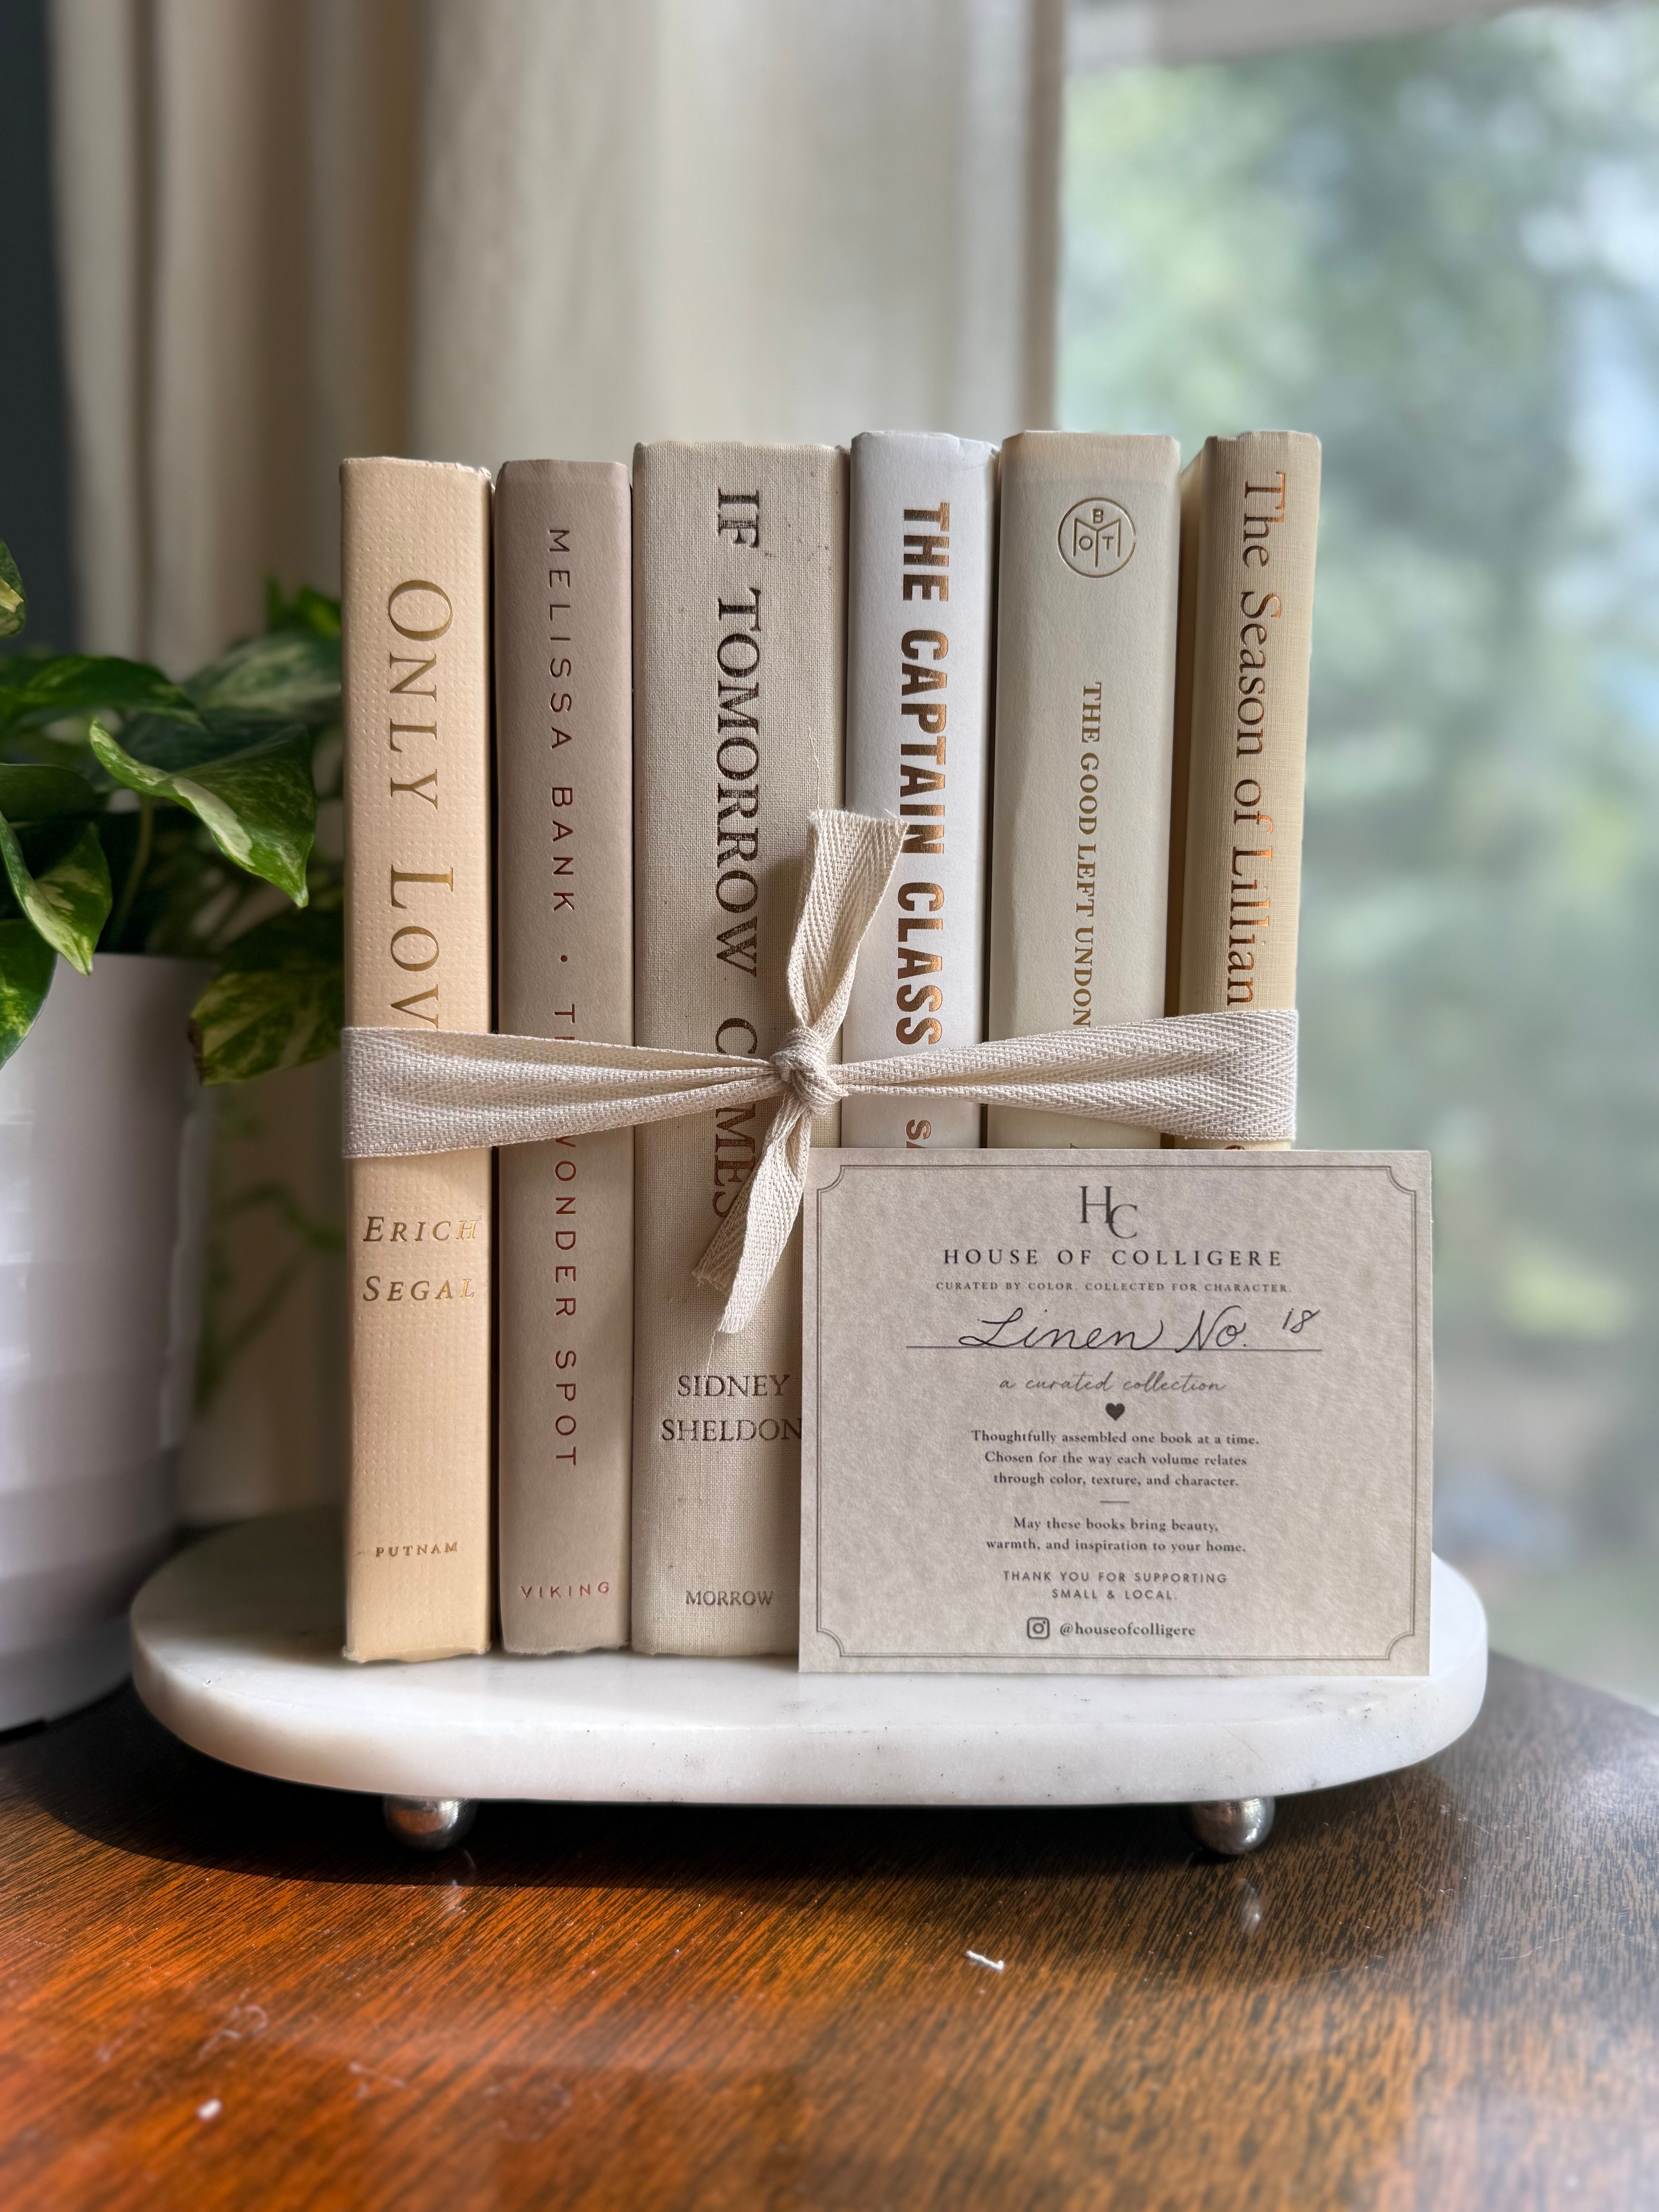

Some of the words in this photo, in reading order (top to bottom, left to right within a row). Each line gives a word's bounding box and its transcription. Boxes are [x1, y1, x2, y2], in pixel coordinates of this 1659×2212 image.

[717, 488, 760, 548] IF
[1242, 472, 1286, 568] The
[903, 502, 950, 602] THE
[550, 529, 572, 749] MELISSA
[388, 580, 453, 810] ONLY
[1236, 591, 1282, 759] Season
[1081, 682, 1102, 743] THE
[900, 629, 949, 854] CAPTAIN
[716, 587, 762, 978] TOMORROW
[1078, 752, 1099, 835] GOOD
[1233, 779, 1273, 834] of
[552, 787, 575, 911] BANK
[1076, 843, 1096, 917] LEFT
[390, 864, 453, 1029] LOV
[1226, 846, 1273, 1006] Lillian
[896, 882, 945, 1045] CLASS
[1073, 925, 1094, 1028] UNDON
[713, 1018, 757, 1218] CMES
[362, 1216, 478, 1242] ERICH
[1079, 1186, 1137, 1239] HC
[943, 1248, 1038, 1265] HOUSE
[1057, 1249, 1091, 1265] OF
[1112, 1249, 1281, 1266] COLLIGERE
[363, 1276, 475, 1302] SEGAL
[936, 1282, 998, 1291] CURATED
[1006, 1282, 1021, 1291] BY
[1028, 1282, 1078, 1291] COLOR.
[1085, 1282, 1164, 1291] COLLECTED
[1171, 1283, 1197, 1291] FOR
[958, 1307, 1163, 1350] Linen
[1175, 1304, 1247, 1353] No.
[1282, 1308, 1321, 1333] 18
[556, 1350, 577, 1466] SPOT
[677, 1374, 790, 1397] SIDNEY
[999, 1379, 1015, 1389] a
[1025, 1371, 1114, 1391] curated
[1123, 1371, 1226, 1393] collection
[661, 1418, 802, 1441] SHELDON
[971, 1429, 1056, 1444] Thoughtfully
[1061, 1431, 1127, 1443] assembled
[1131, 1435, 1155, 1443] one
[1160, 1432, 1192, 1444] book
[1197, 1435, 1209, 1444] at
[1214, 1436, 1221, 1444] a
[1226, 1434, 1259, 1445] time.
[984, 1451, 1033, 1463] Chosen
[1039, 1451, 1057, 1463] for
[1063, 1451, 1083, 1463] the
[1088, 1456, 1112, 1466] way
[1117, 1452, 1146, 1464] each
[1151, 1453, 1199, 1465] volume
[1204, 1453, 1247, 1465] relates
[993, 1471, 1044, 1486] through
[1049, 1472, 1086, 1485] color,
[1091, 1476, 1141, 1486] texture,
[1146, 1474, 1170, 1486] and
[1175, 1474, 1239, 1487] character.
[375, 1541, 458, 1557] PUTNAM
[986, 1537, 1040, 1550] warmth,
[1046, 1538, 1070, 1550] and
[1075, 1539, 1147, 1553] inspiration
[1152, 1542, 1166, 1551] to
[1171, 1544, 1201, 1553] your
[1206, 1540, 1246, 1552] home.
[1013, 1516, 1041, 1530] May
[1046, 1516, 1081, 1529] these
[1085, 1517, 1125, 1530] books
[1130, 1517, 1166, 1532] bring
[1171, 1518, 1219, 1533] beauty,
[521, 1581, 610, 1599] VIKING
[685, 1590, 774, 1606] MORROW
[1003, 1570, 1051, 1581] THANK
[1060, 1571, 1089, 1582] YOU
[1098, 1571, 1125, 1582] FOR
[1134, 1572, 1227, 1583] SUPPORTING
[1052, 1589, 1097, 1599] SMALL
[1107, 1589, 1115, 1599] &
[1060, 1621, 1196, 1638] @houseofcolligere
